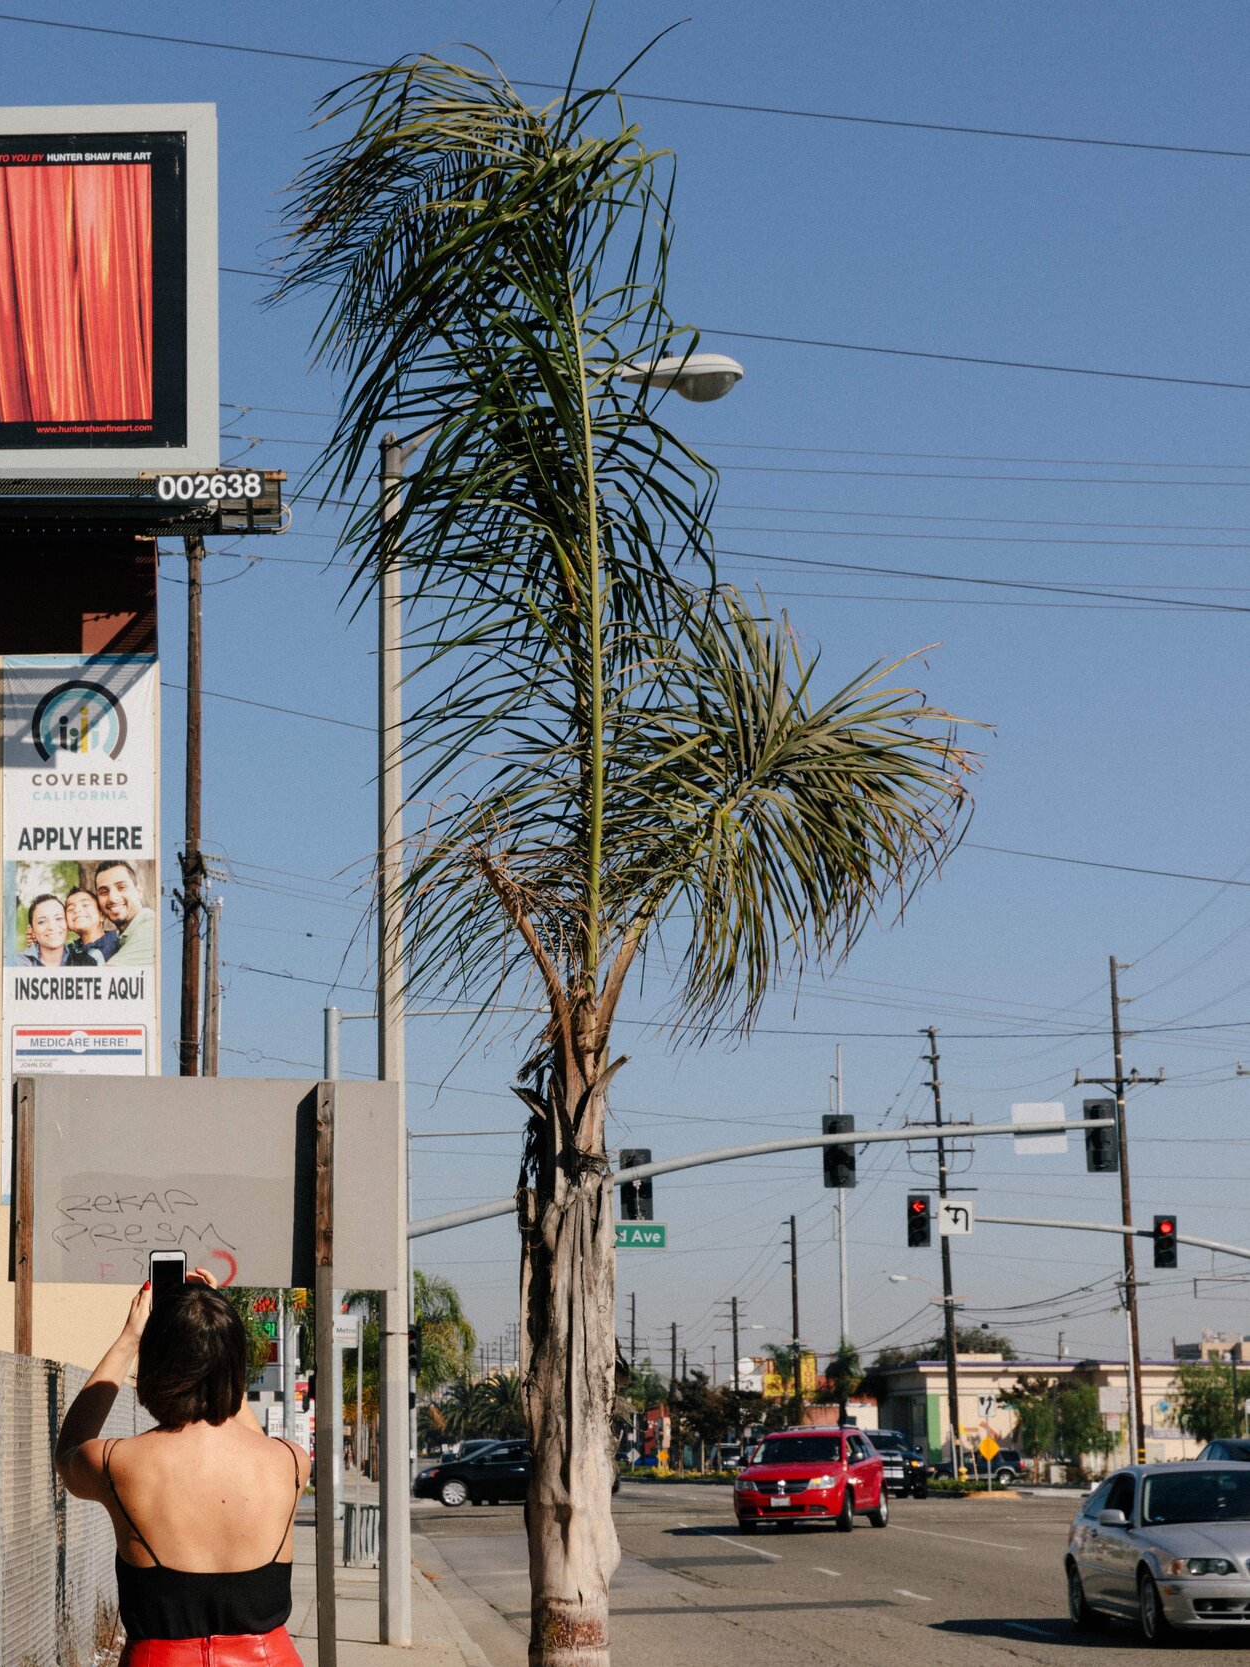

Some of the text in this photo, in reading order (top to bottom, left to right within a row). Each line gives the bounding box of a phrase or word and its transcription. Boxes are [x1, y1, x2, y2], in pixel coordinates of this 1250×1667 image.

[11, 154, 30, 162] YOU
[31, 153, 44, 162] BY
[46, 153, 83, 162] HUNTER
[84, 152, 111, 161] SHAW
[112, 152, 132, 160] FINE
[133, 151, 152, 160] ART
[36, 424, 152, 433] www.huntershawfineart.com
[158, 473, 261, 500] 002638
[32, 773, 128, 787] COVERED
[32, 790, 128, 801] CALIFORNIA
[18, 826, 142, 850] APPLY HERE
[15, 970, 144, 1000] INSCRIBETE AQUÍ
[30, 1037, 128, 1047] MEDICARE HERE!
[630, 1229, 661, 1243] Ave
